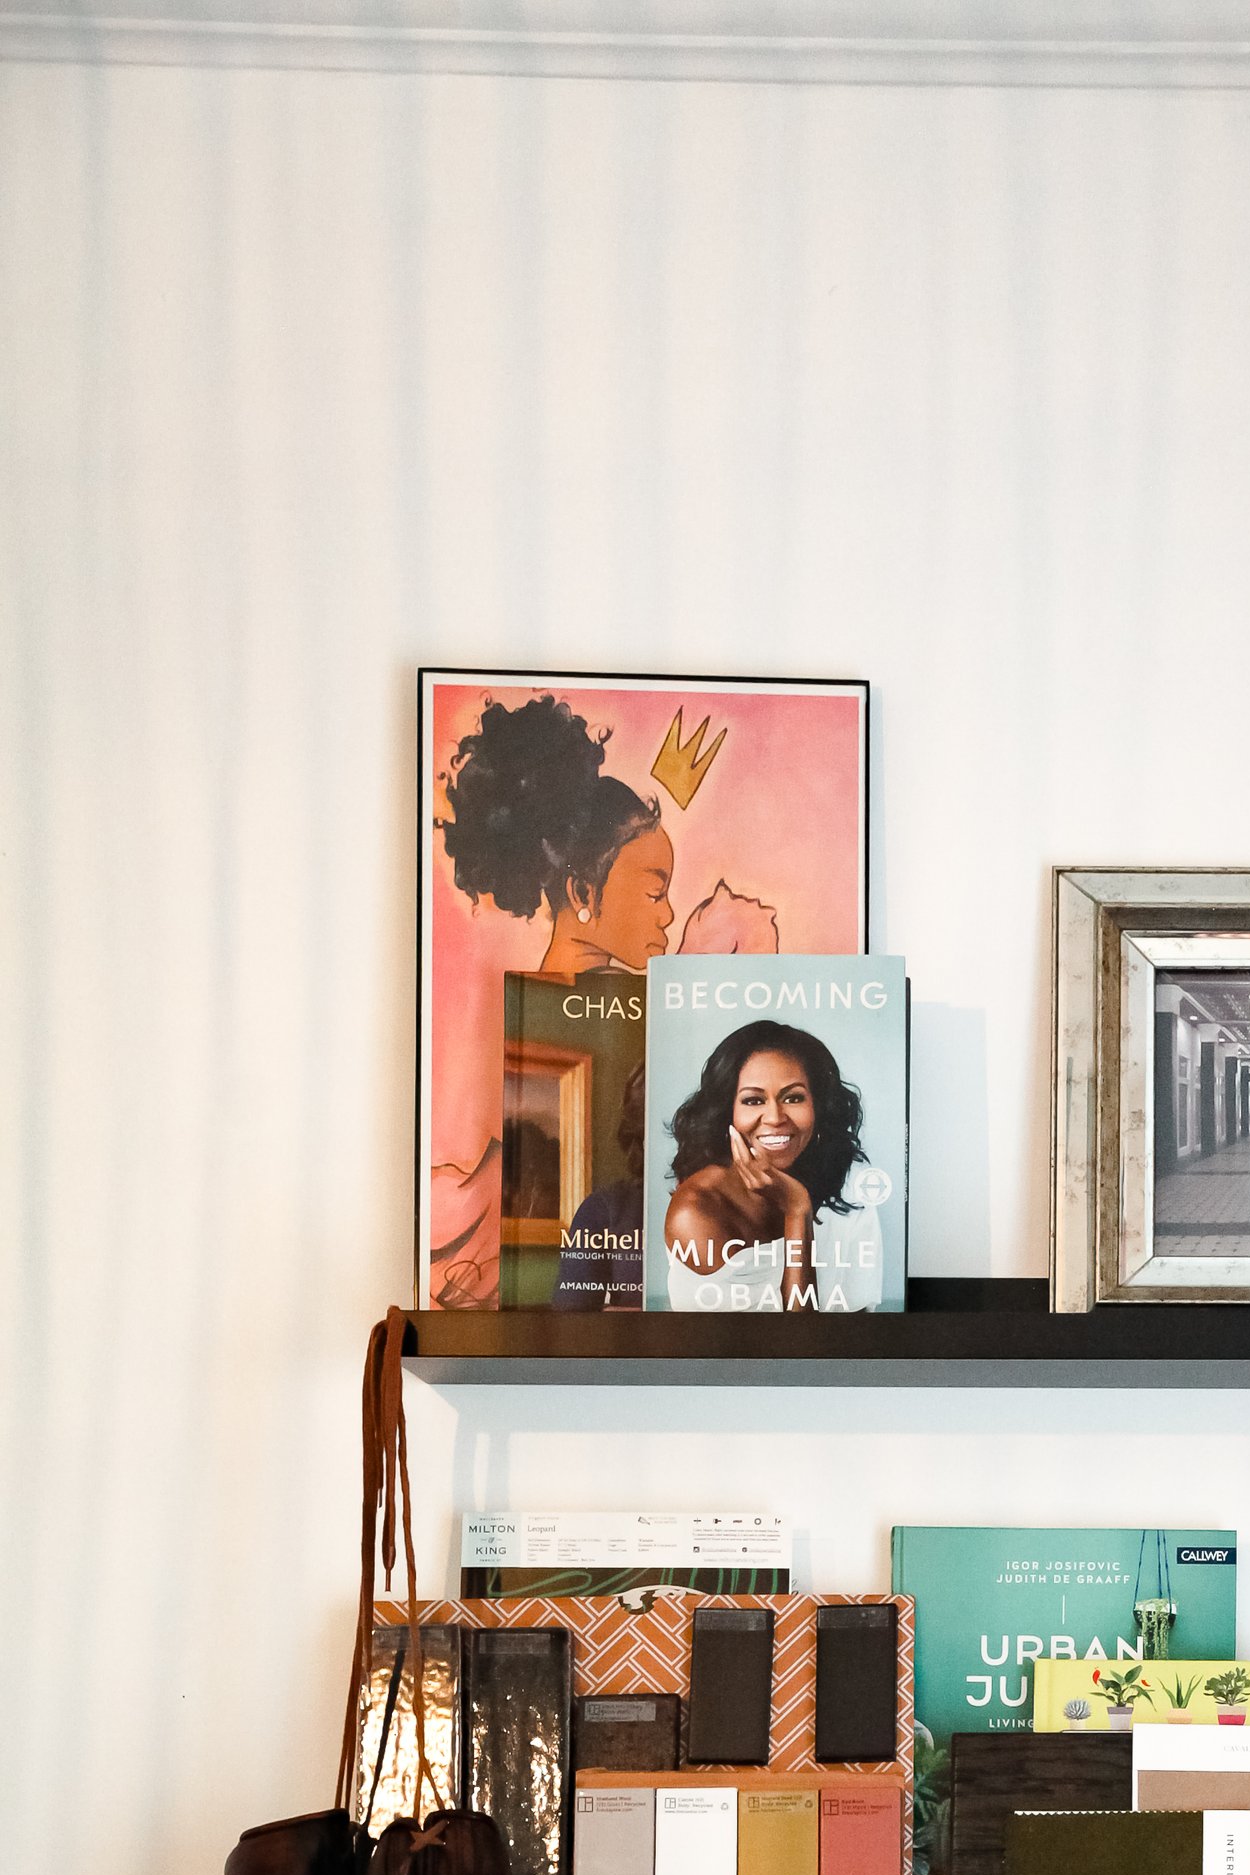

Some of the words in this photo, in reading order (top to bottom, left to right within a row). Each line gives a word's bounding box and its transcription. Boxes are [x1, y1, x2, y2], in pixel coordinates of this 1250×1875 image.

[665, 981, 888, 1010] BECOMING
[562, 994, 642, 1021] CHAS
[560, 1251, 605, 1260] THROUGH
[606, 1252, 623, 1260] THE
[625, 1253, 643, 1261] LEN
[667, 1239, 876, 1268] MICHELLE
[560, 1281, 605, 1291] AMANDA
[606, 1282, 644, 1292] LUCIDO
[694, 1283, 850, 1311] OBAMA
[468, 1525, 516, 1533] MILTON
[527, 1524, 556, 1534] Leopard
[475, 1546, 507, 1555] KING
[1180, 1550, 1229, 1561] CALLWEY
[1006, 1560, 1040, 1571] IGOR
[1046, 1561, 1121, 1571] JOSIFOVIC
[996, 1574, 1047, 1583] JUDITH
[1053, 1574, 1070, 1583] DE
[1076, 1574, 1131, 1584] GRAAFF
[980, 1634, 1144, 1666] URBAN
[965, 1675, 1028, 1707] JU
